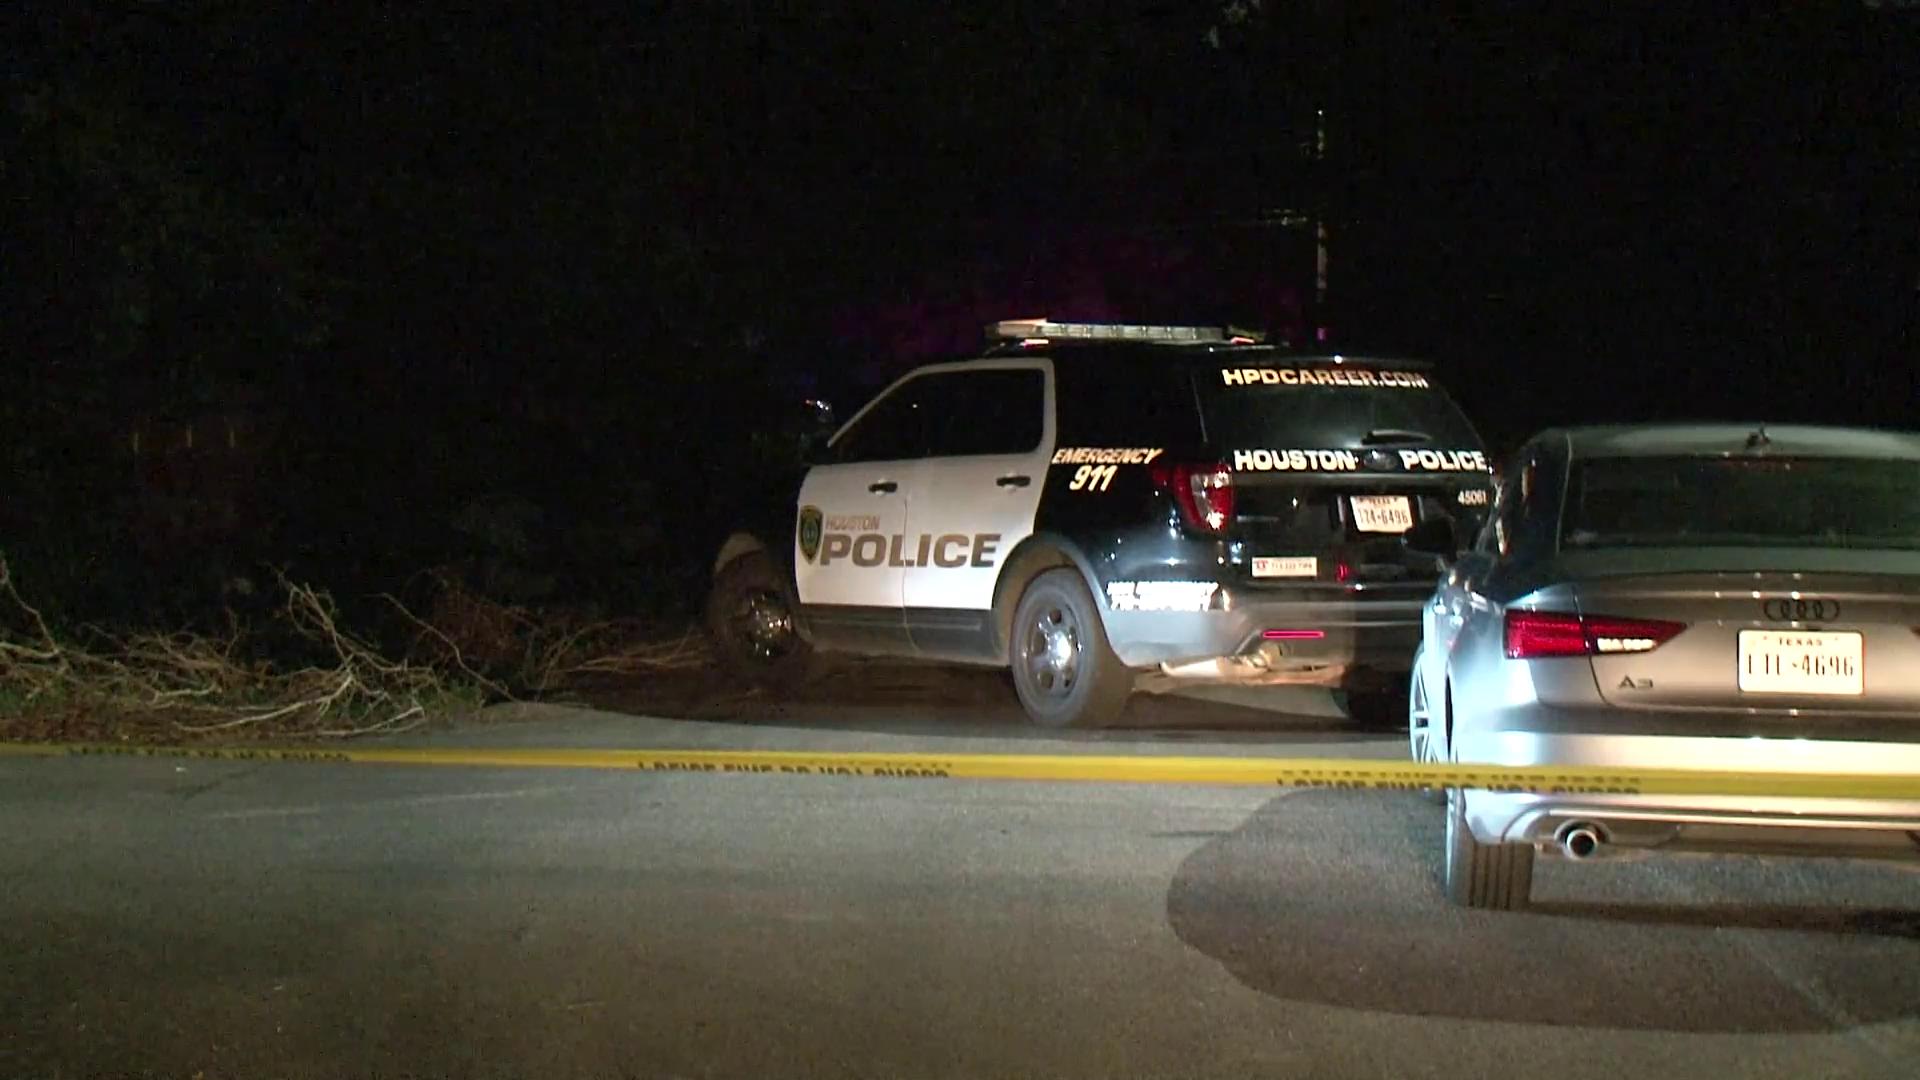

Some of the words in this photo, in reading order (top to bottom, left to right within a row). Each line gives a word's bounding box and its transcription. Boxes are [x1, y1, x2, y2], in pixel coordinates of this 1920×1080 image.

[1051, 447, 1164, 465] EMERGENCY
[1233, 449, 1357, 471] HOUSTON
[1398, 449, 1488, 471] POLICE
[1069, 465, 1119, 492] 911
[825, 514, 882, 531] HOUSTON
[819, 533, 1002, 568] POLICE
[1778, 637, 1824, 647] TEXAS
